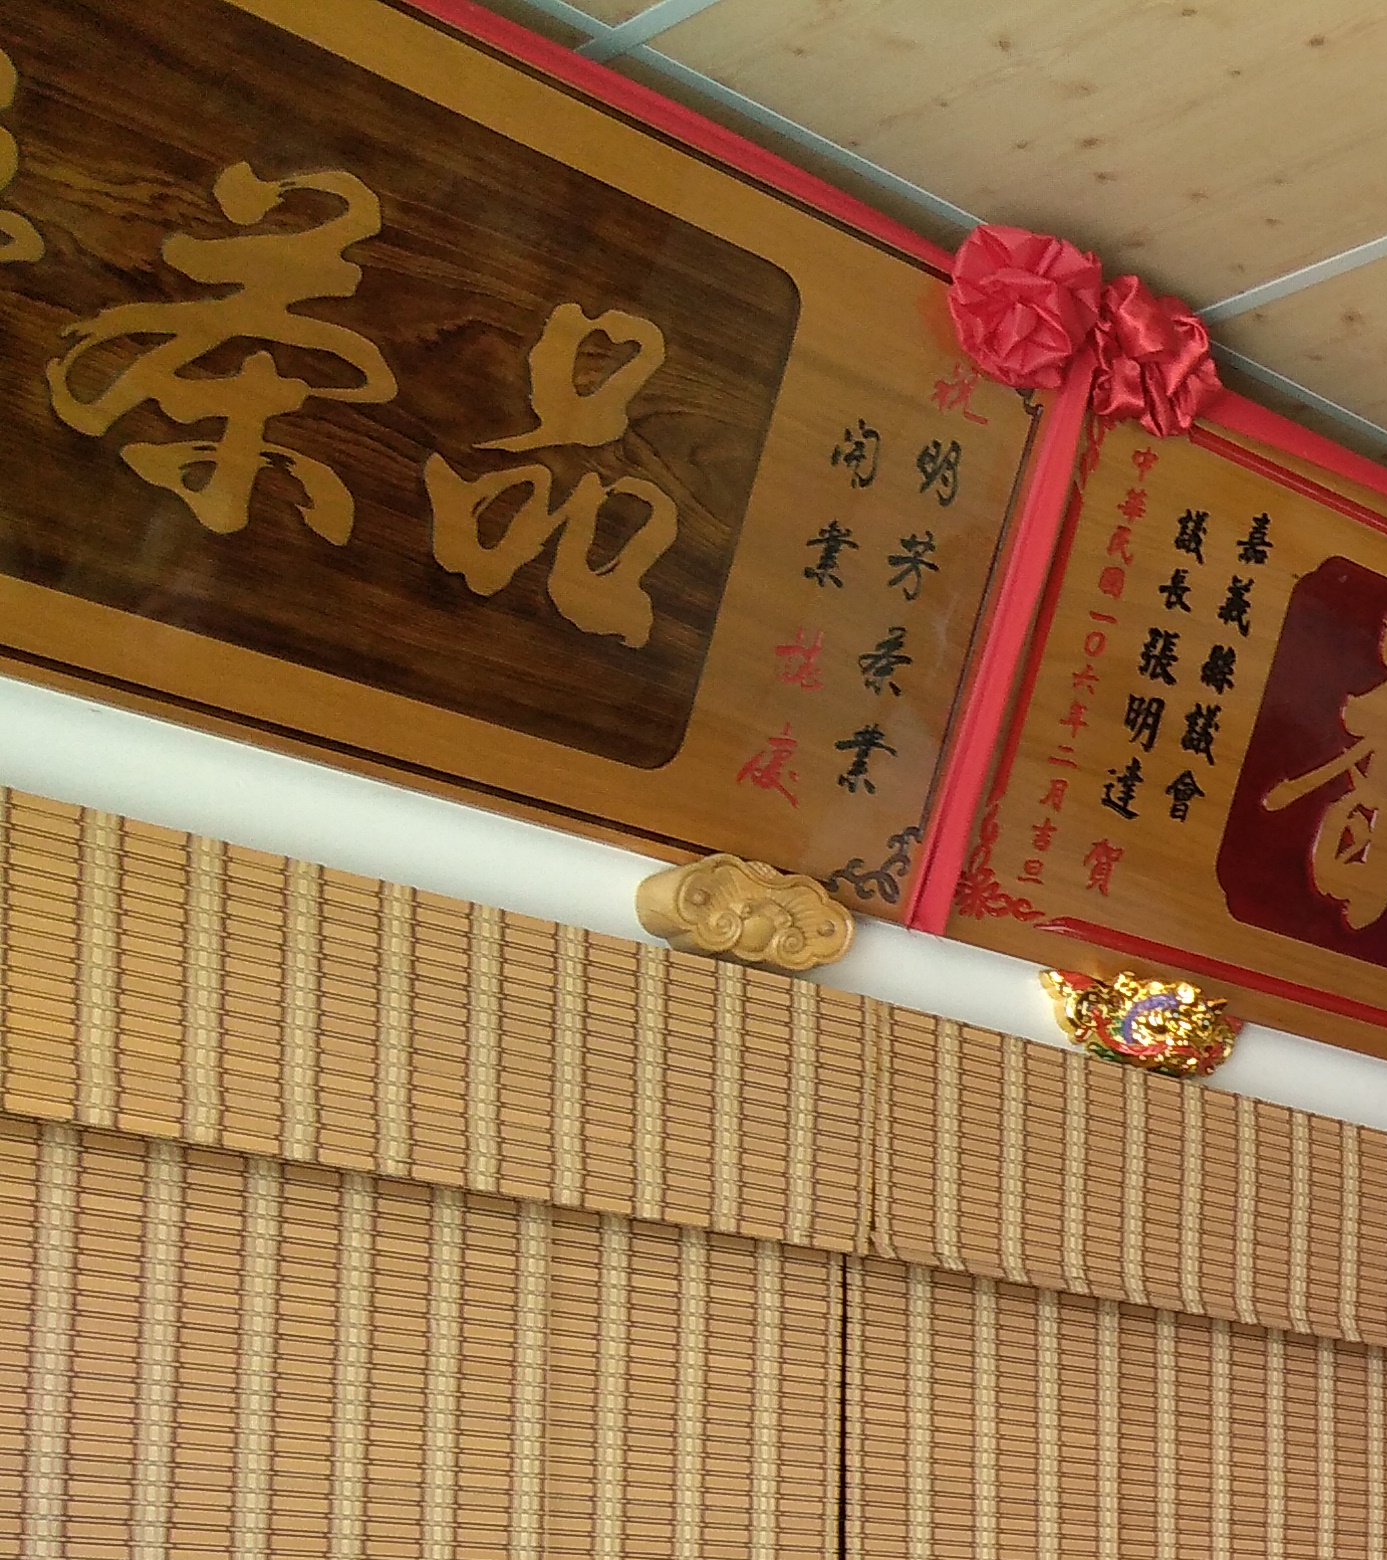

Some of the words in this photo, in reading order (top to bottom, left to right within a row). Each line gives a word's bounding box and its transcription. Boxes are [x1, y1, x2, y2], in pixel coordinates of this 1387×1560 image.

[1163, 511, 1275, 824] 嘉義縣議會
